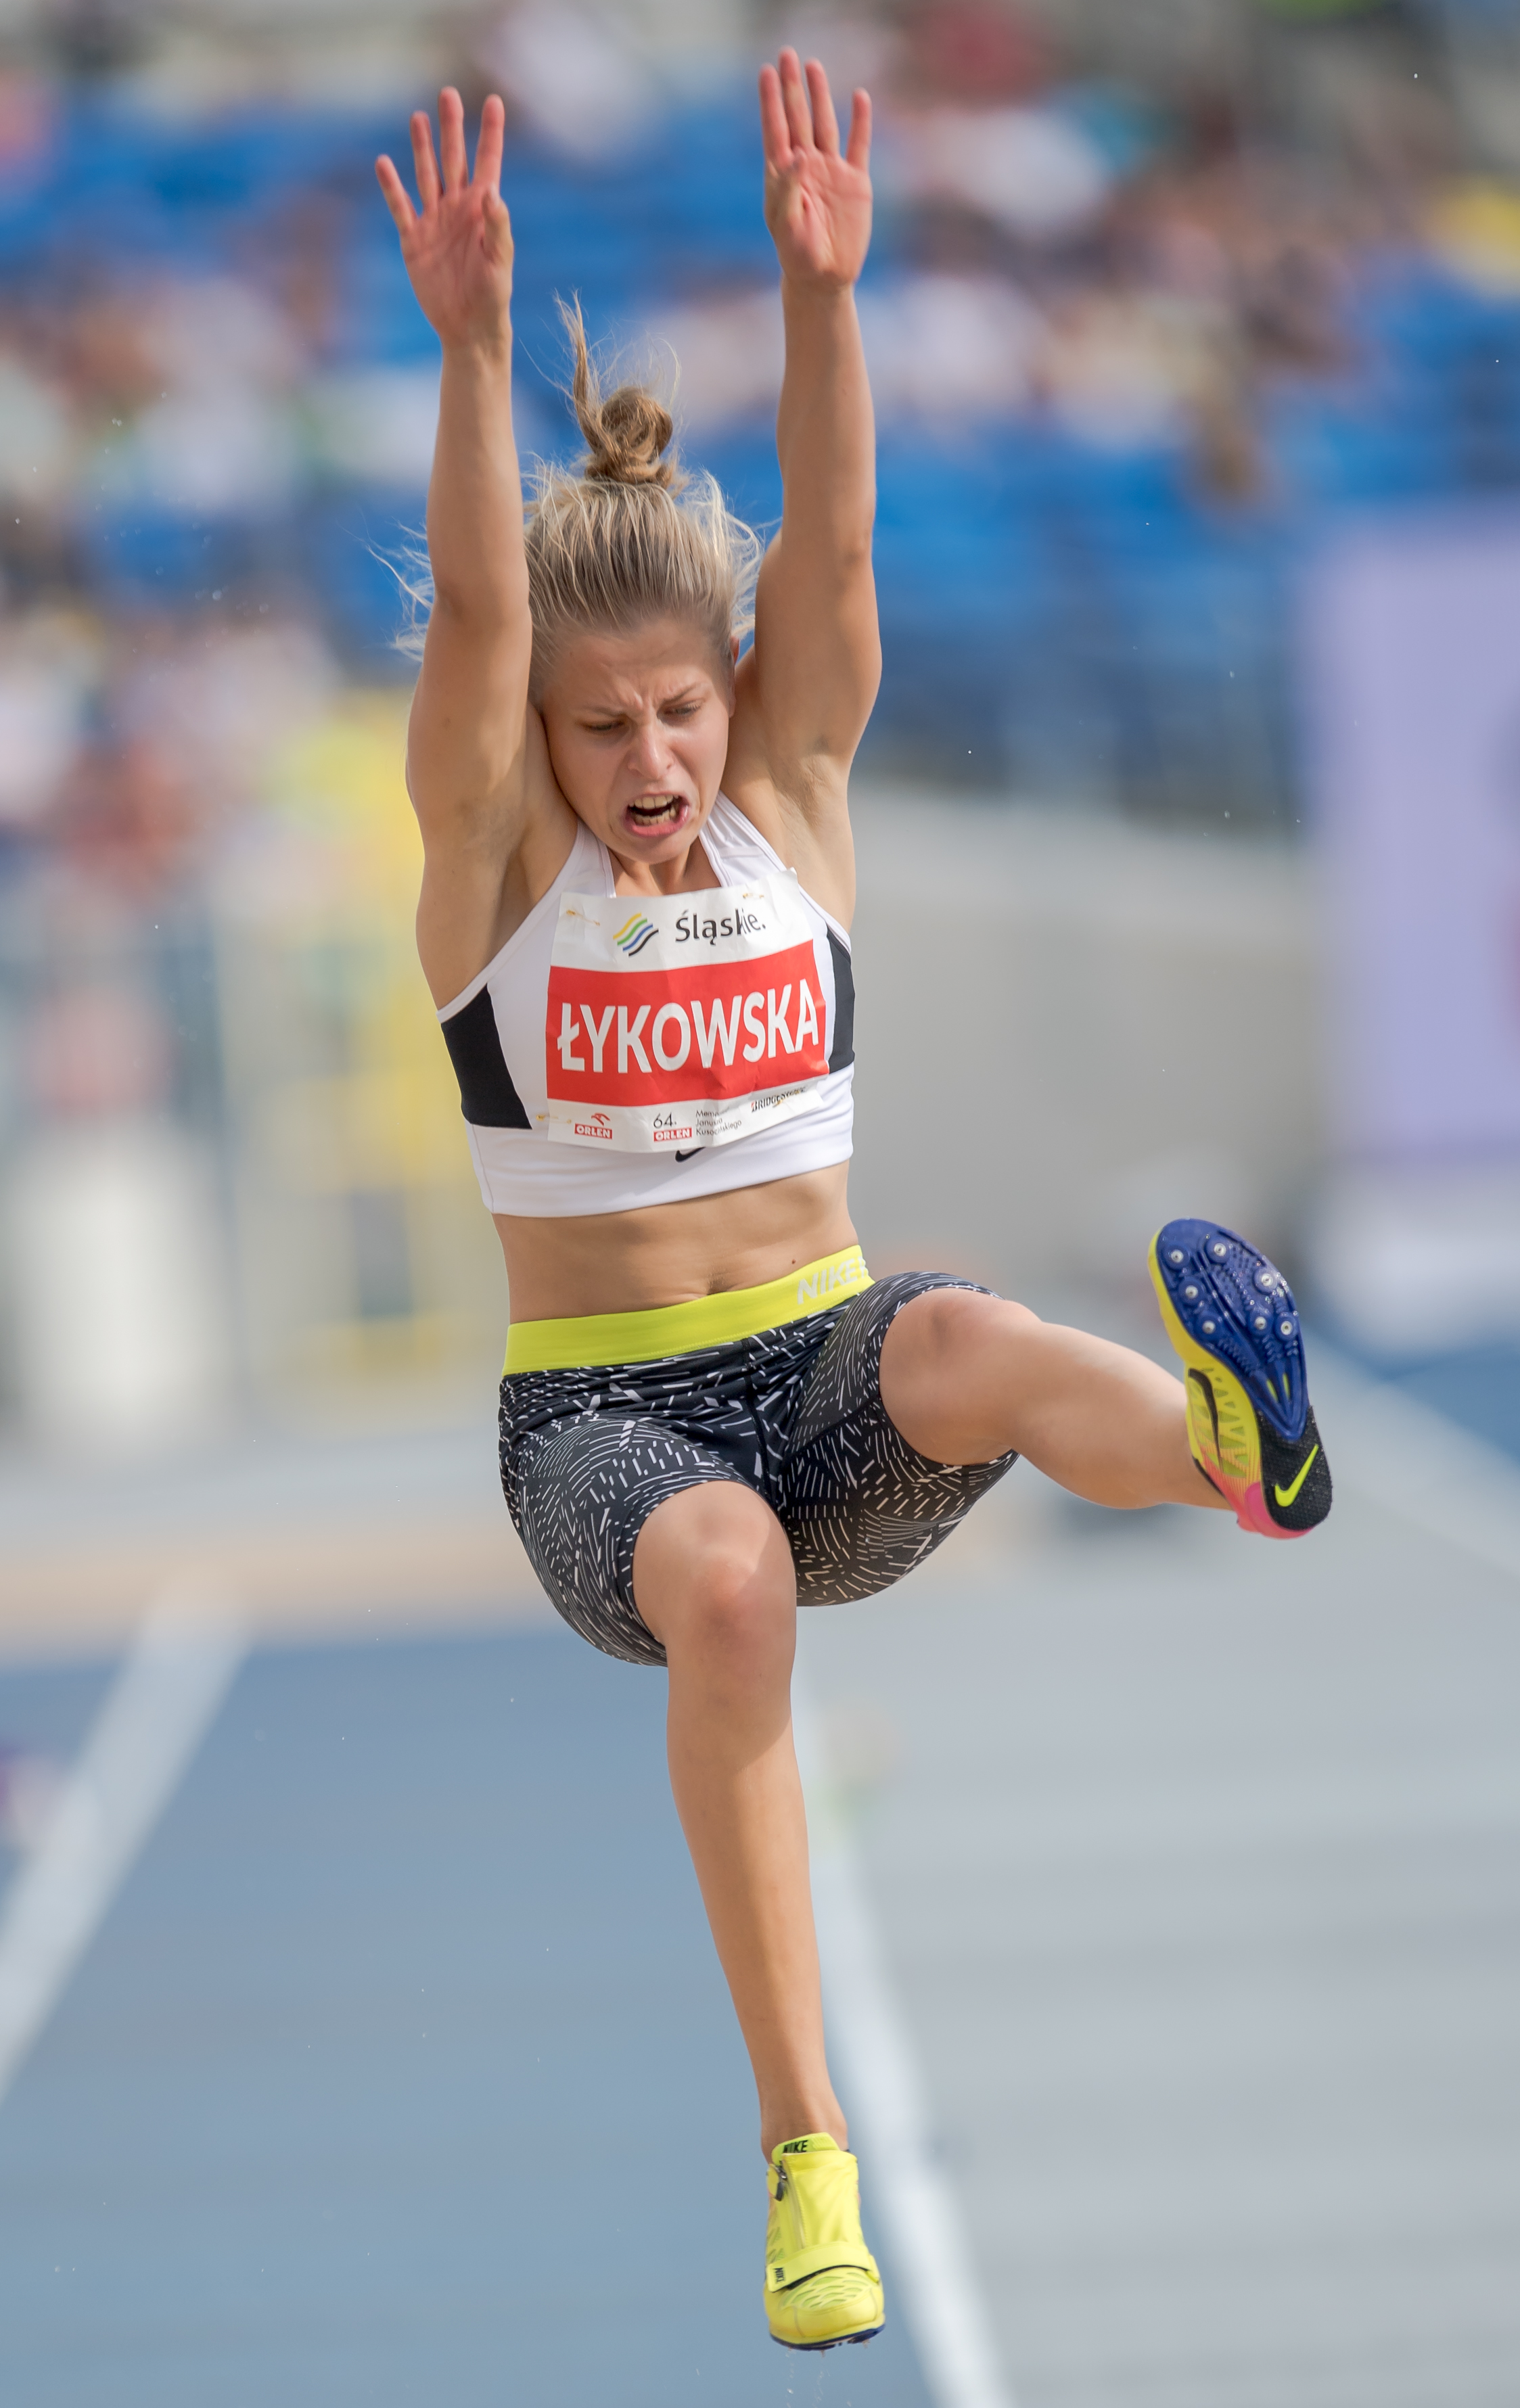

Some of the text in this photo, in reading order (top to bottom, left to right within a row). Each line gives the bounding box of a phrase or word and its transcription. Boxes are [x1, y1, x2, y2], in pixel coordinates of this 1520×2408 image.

[675, 908, 766, 946] Śląskie.
[557, 978, 819, 1073] ŁYKOWSKA
[750, 1086, 806, 1113] BRIDGEST
[576, 1126, 610, 1138] ORLEN
[653, 1112, 677, 1129] 64.
[655, 1129, 691, 1141] ORLEN
[797, 1258, 858, 1305] NIKE
